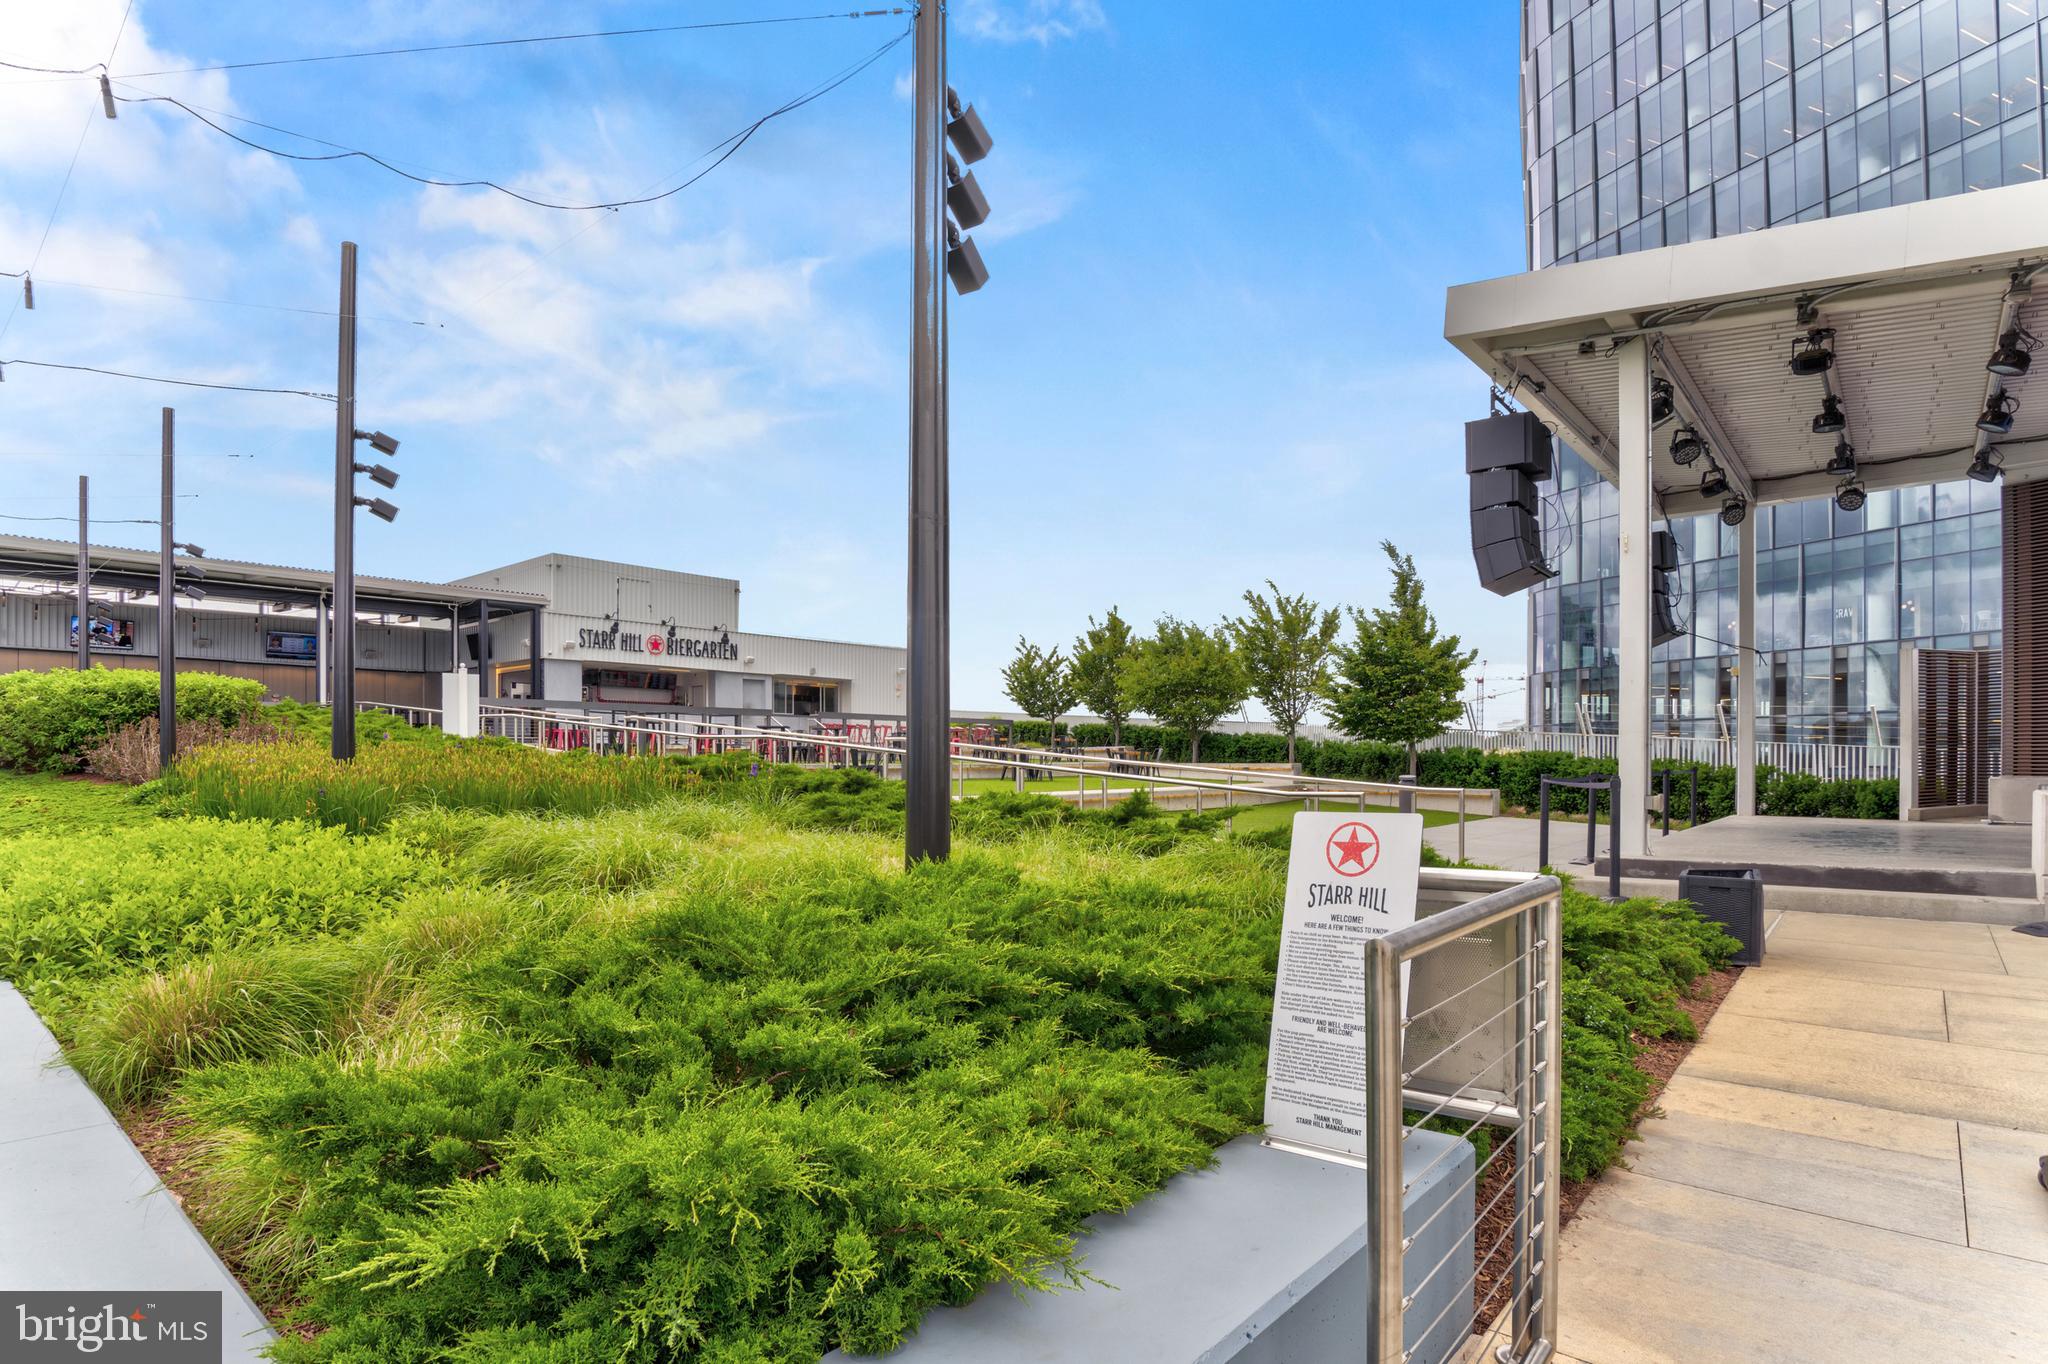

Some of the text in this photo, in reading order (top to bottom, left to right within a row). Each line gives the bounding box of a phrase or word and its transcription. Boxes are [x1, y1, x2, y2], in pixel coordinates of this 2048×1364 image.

[579, 628, 738, 661] STARR HILL BIERGARTEN
[1307, 883, 1389, 914] STARR HILL
[1330, 913, 1364, 924] WELCOME!
[1303, 921, 1317, 929] HERE
[1318, 922, 1328, 930] ARE
[1328, 923, 1332, 931] A
[1345, 924, 1364, 933] THINGS
[1364, 926, 1371, 934] TO
[1291, 1015, 1315, 1025] FRIENDLY
[1316, 1018, 1327, 1027] AND
[1316, 1025, 1353, 1037] ARE WELCOME
[1313, 1113, 1330, 1123] THANK
[1295, 1116, 1362, 1137] STARR HILL MANAGEMENT
